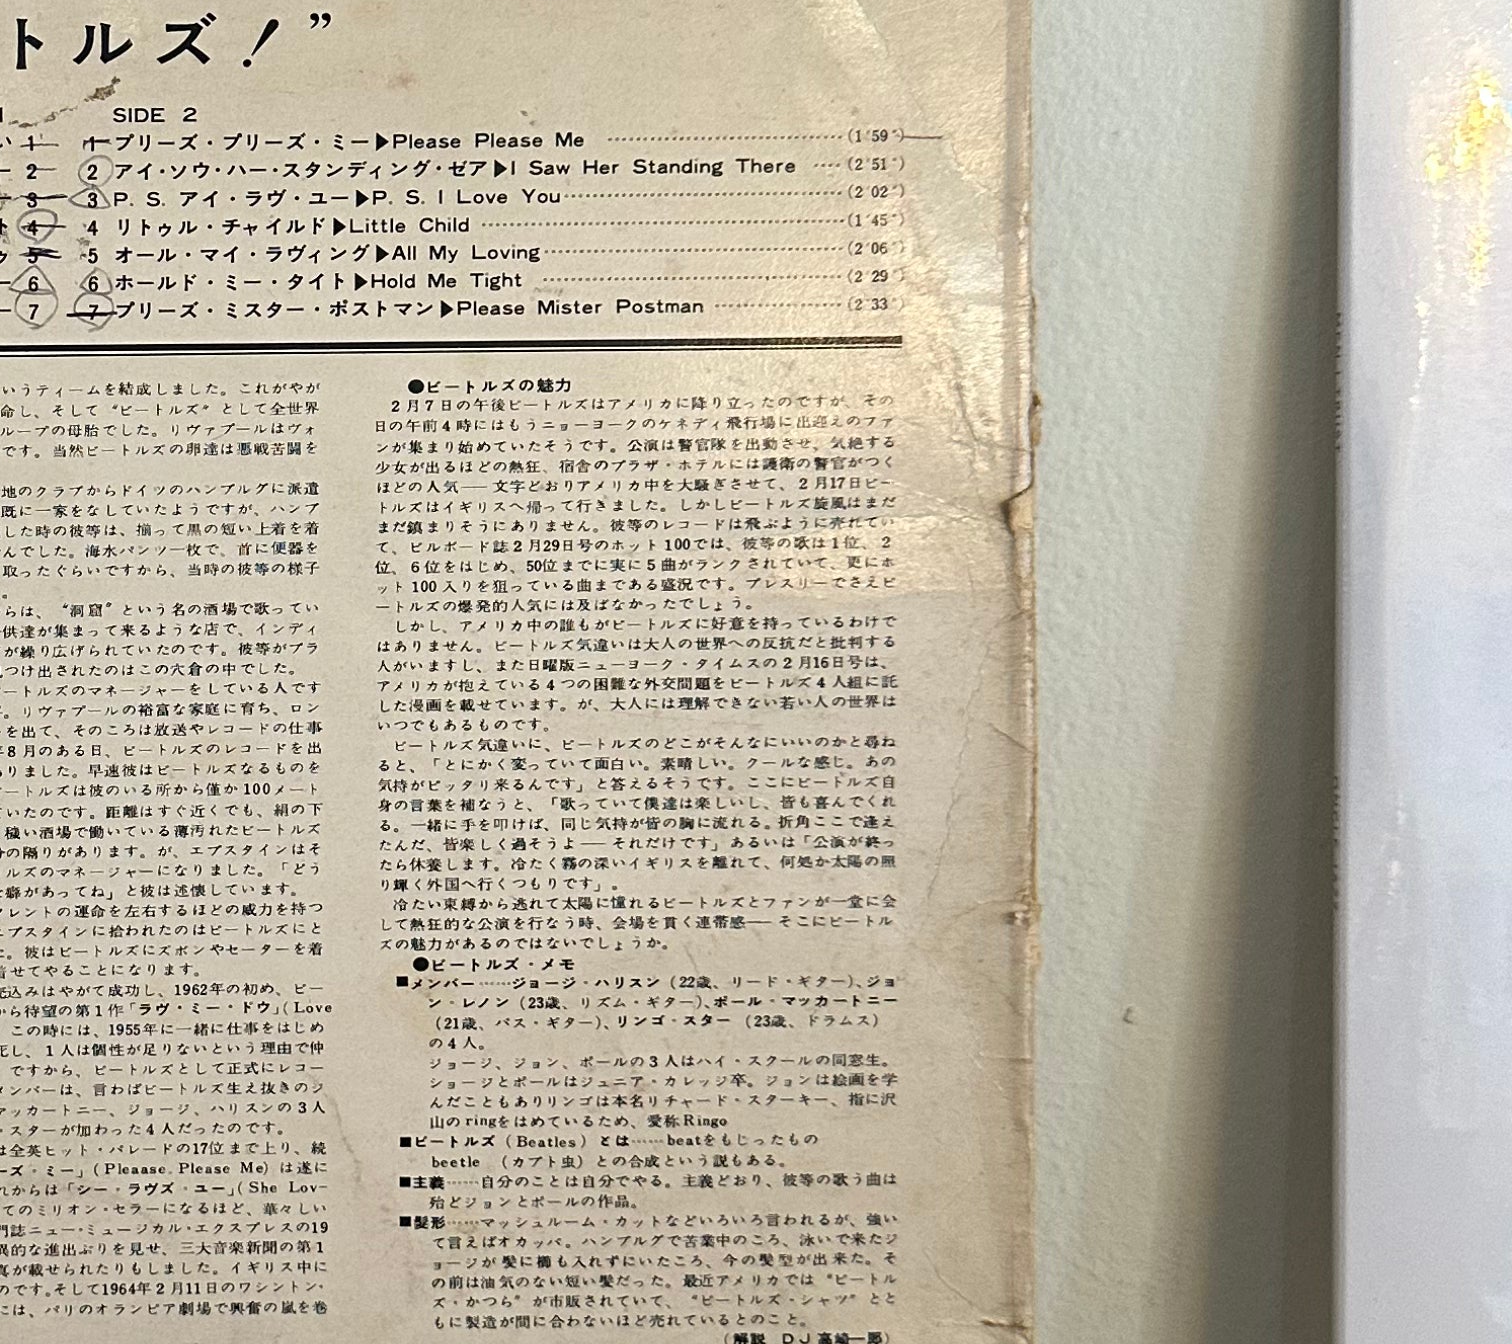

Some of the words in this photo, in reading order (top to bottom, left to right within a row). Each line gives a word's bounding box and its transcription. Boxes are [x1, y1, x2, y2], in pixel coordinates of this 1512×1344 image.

[112, 107, 166, 123] SIDE
[182, 107, 198, 123] 2
[392, 133, 462, 150] Please
[474, 132, 544, 149] Please
[555, 131, 585, 148] Me
[26, 164, 38, 180] 2
[87, 164, 98, 181] 2
[510, 160, 516, 176] I
[529, 159, 571, 176] Saw
[582, 158, 619, 176] Her
[632, 158, 724, 177] Standing
[735, 158, 796, 174] There
[87, 192, 98, 208] 3
[113, 191, 134, 207] P.
[146, 191, 166, 207] S.
[372, 190, 393, 206] P.
[405, 190, 425, 206] S.
[438, 189, 444, 205] I
[457, 189, 508, 205] Love
[522, 188, 561, 205] You
[87, 220, 99, 236] 4
[349, 217, 406, 234] Little
[419, 217, 470, 233] Child
[87, 247, 99, 265] 5
[392, 245, 416, 261] All
[429, 245, 458, 264] My
[472, 244, 541, 263] Loving
[27, 275, 39, 293] 6
[88, 275, 99, 293] 6
[371, 273, 416, 289] Hold
[427, 273, 457, 289] Me
[470, 272, 522, 291] Tight
[28, 304, 39, 321] 7
[457, 300, 525, 317] Please
[537, 299, 603, 315] Mister
[615, 298, 704, 314] Postman
[431, 1155, 481, 1169] beetle
